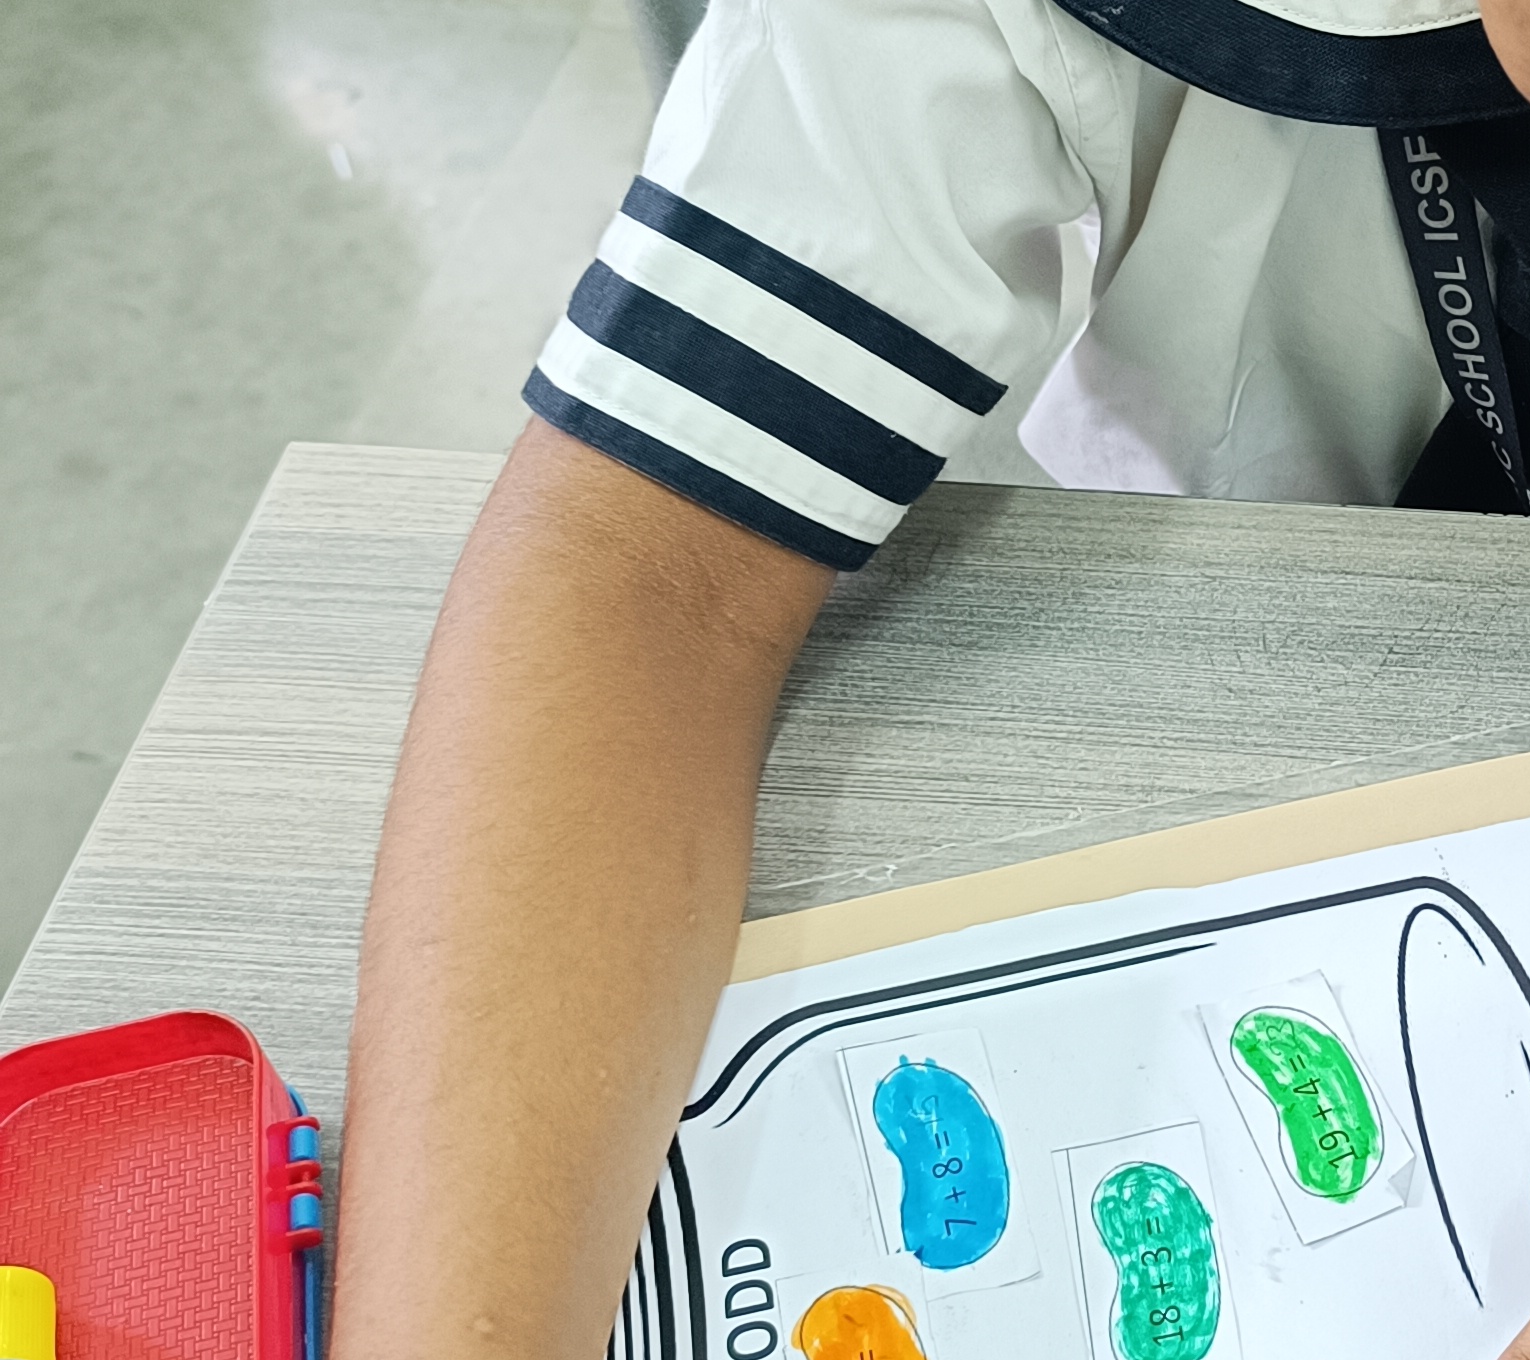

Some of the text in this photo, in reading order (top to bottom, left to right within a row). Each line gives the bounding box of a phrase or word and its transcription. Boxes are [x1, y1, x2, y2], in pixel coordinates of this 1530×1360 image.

[1433, 255, 1504, 435] SCHOOL
[1293, 1077, 1321, 1095] 4
[1319, 1130, 1359, 1169] 19
[932, 1157, 963, 1179] 8
[944, 1219, 977, 1237] 7
[1141, 1246, 1172, 1267] 3
[1149, 1305, 1185, 1347] 18
